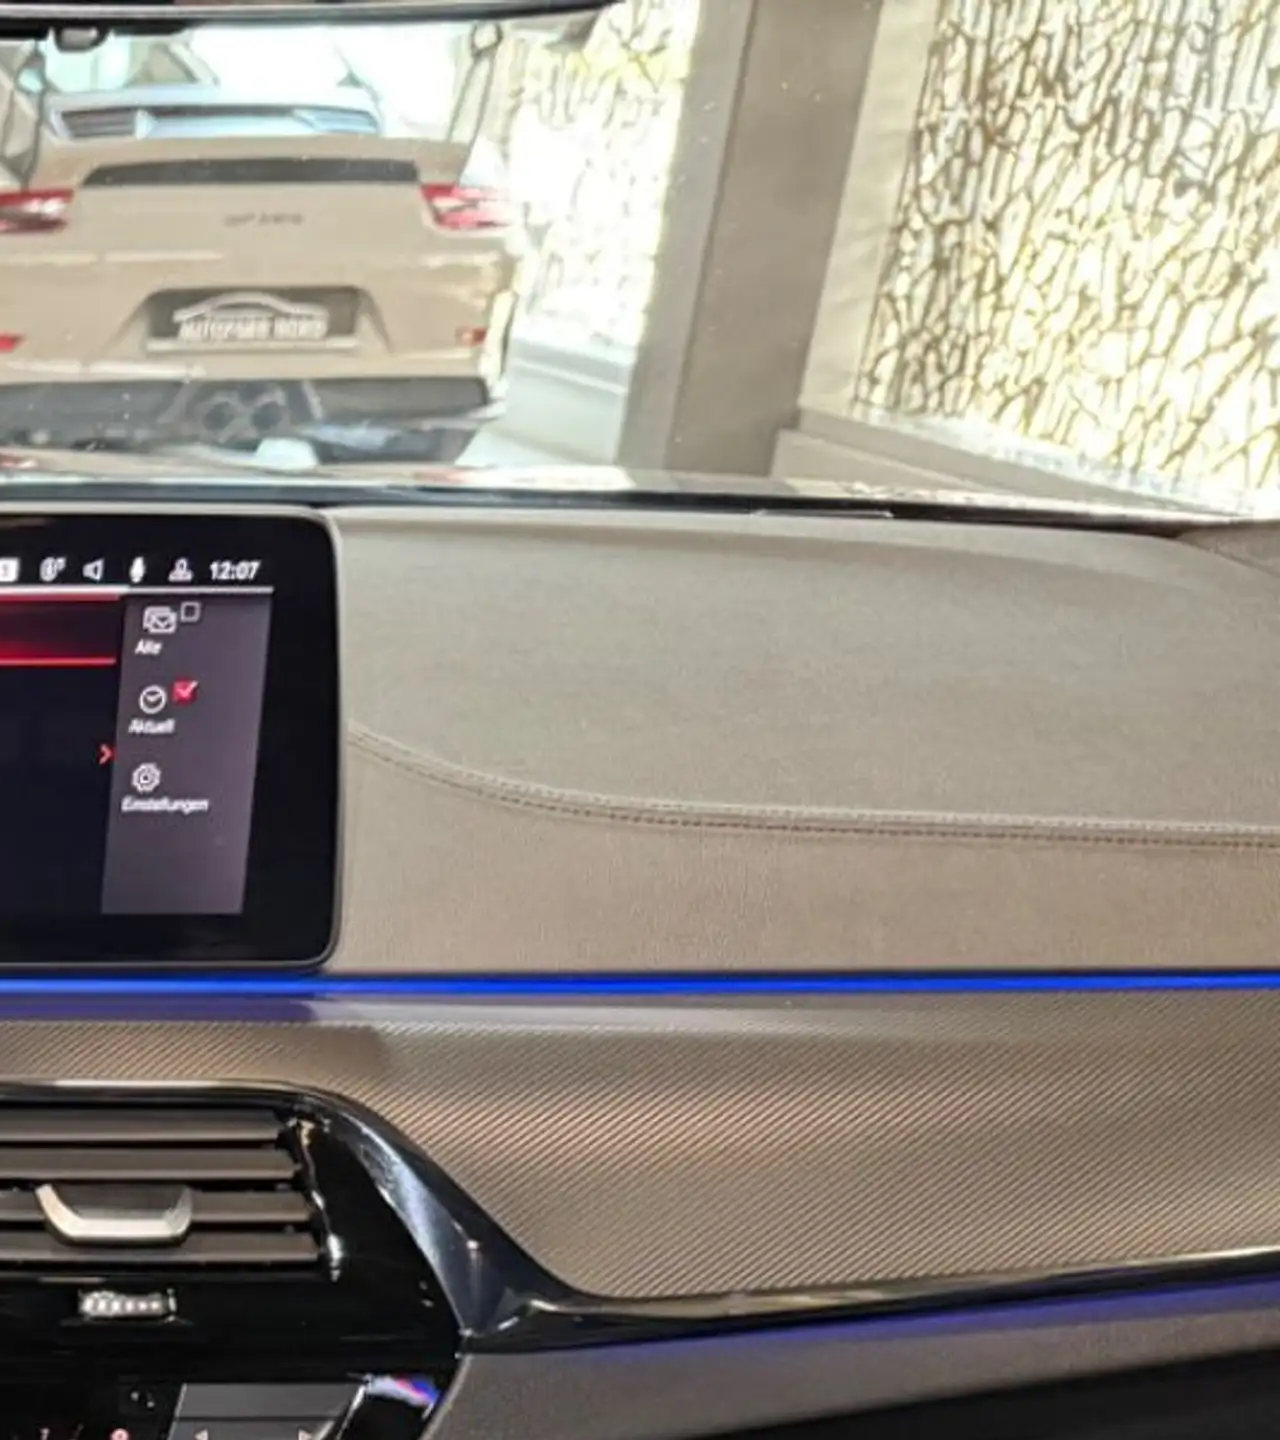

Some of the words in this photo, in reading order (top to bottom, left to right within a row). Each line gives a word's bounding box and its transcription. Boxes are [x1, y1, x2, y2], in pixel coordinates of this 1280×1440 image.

[209, 561, 261, 581] 12:07
[128, 718, 175, 734] Aktuell
[121, 796, 210, 815] Einstellungen
